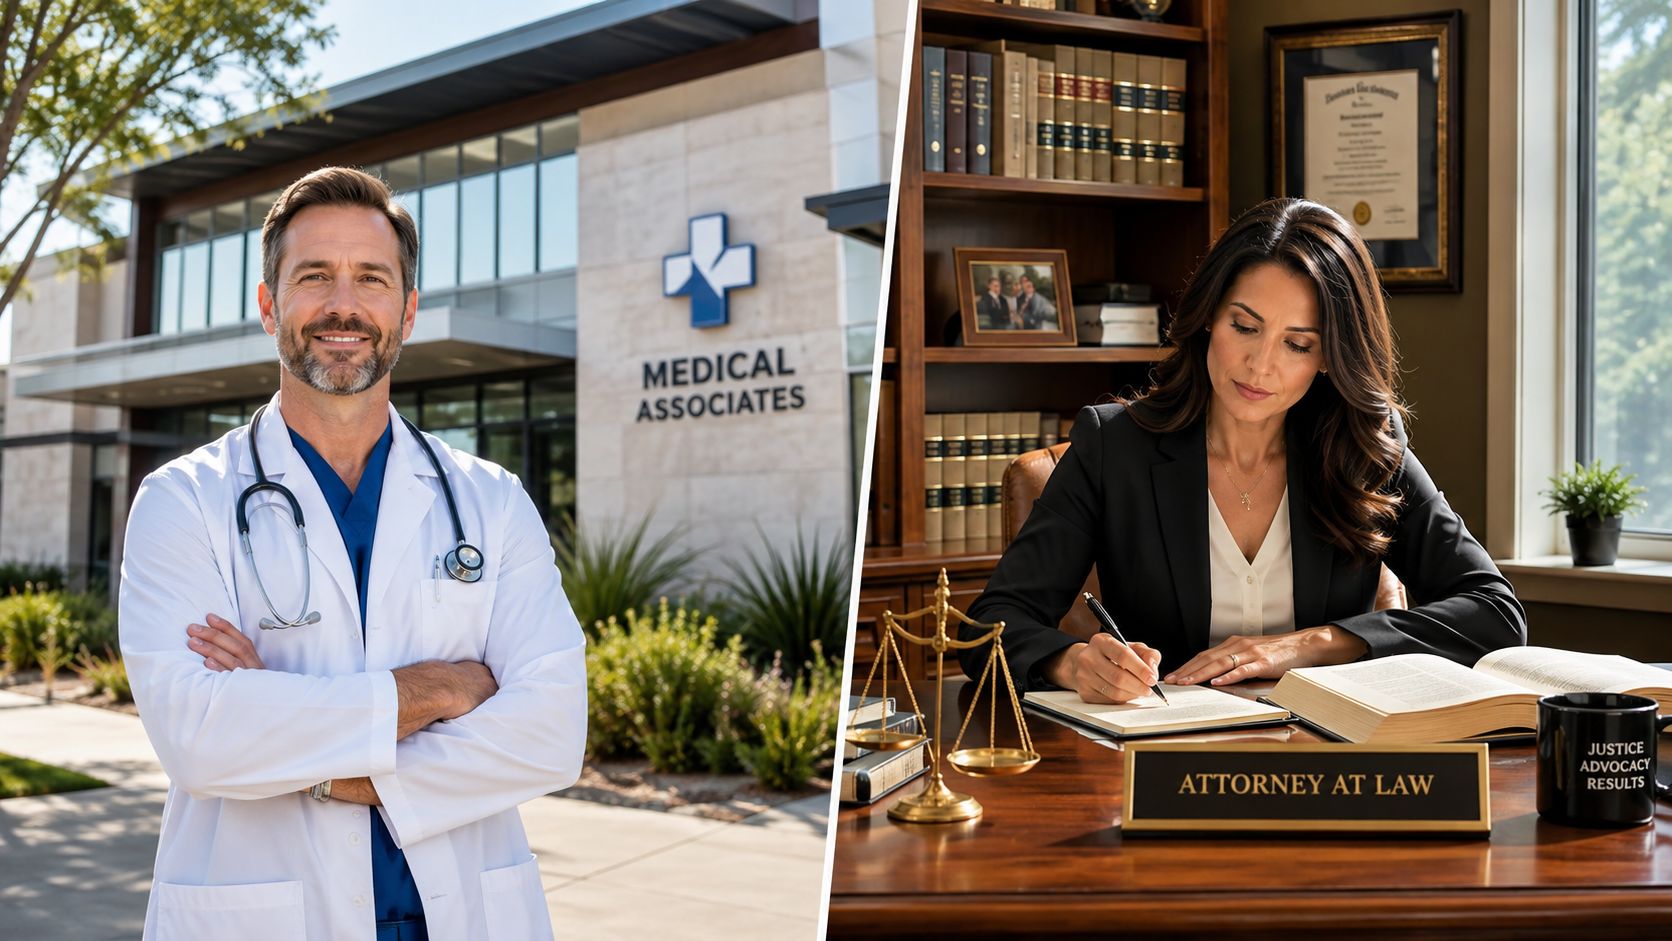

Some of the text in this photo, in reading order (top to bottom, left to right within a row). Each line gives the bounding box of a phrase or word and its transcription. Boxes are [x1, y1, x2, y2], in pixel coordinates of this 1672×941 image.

[643, 347, 795, 390] MEDICAL
[636, 385, 805, 422] ASSOCIATES
[1587, 741, 1644, 756] JUSTICE
[1579, 757, 1651, 773] ADVOCACY
[1177, 773, 1434, 795] ATTORNEY AT LAW
[1587, 776, 1644, 790] RESULTS
